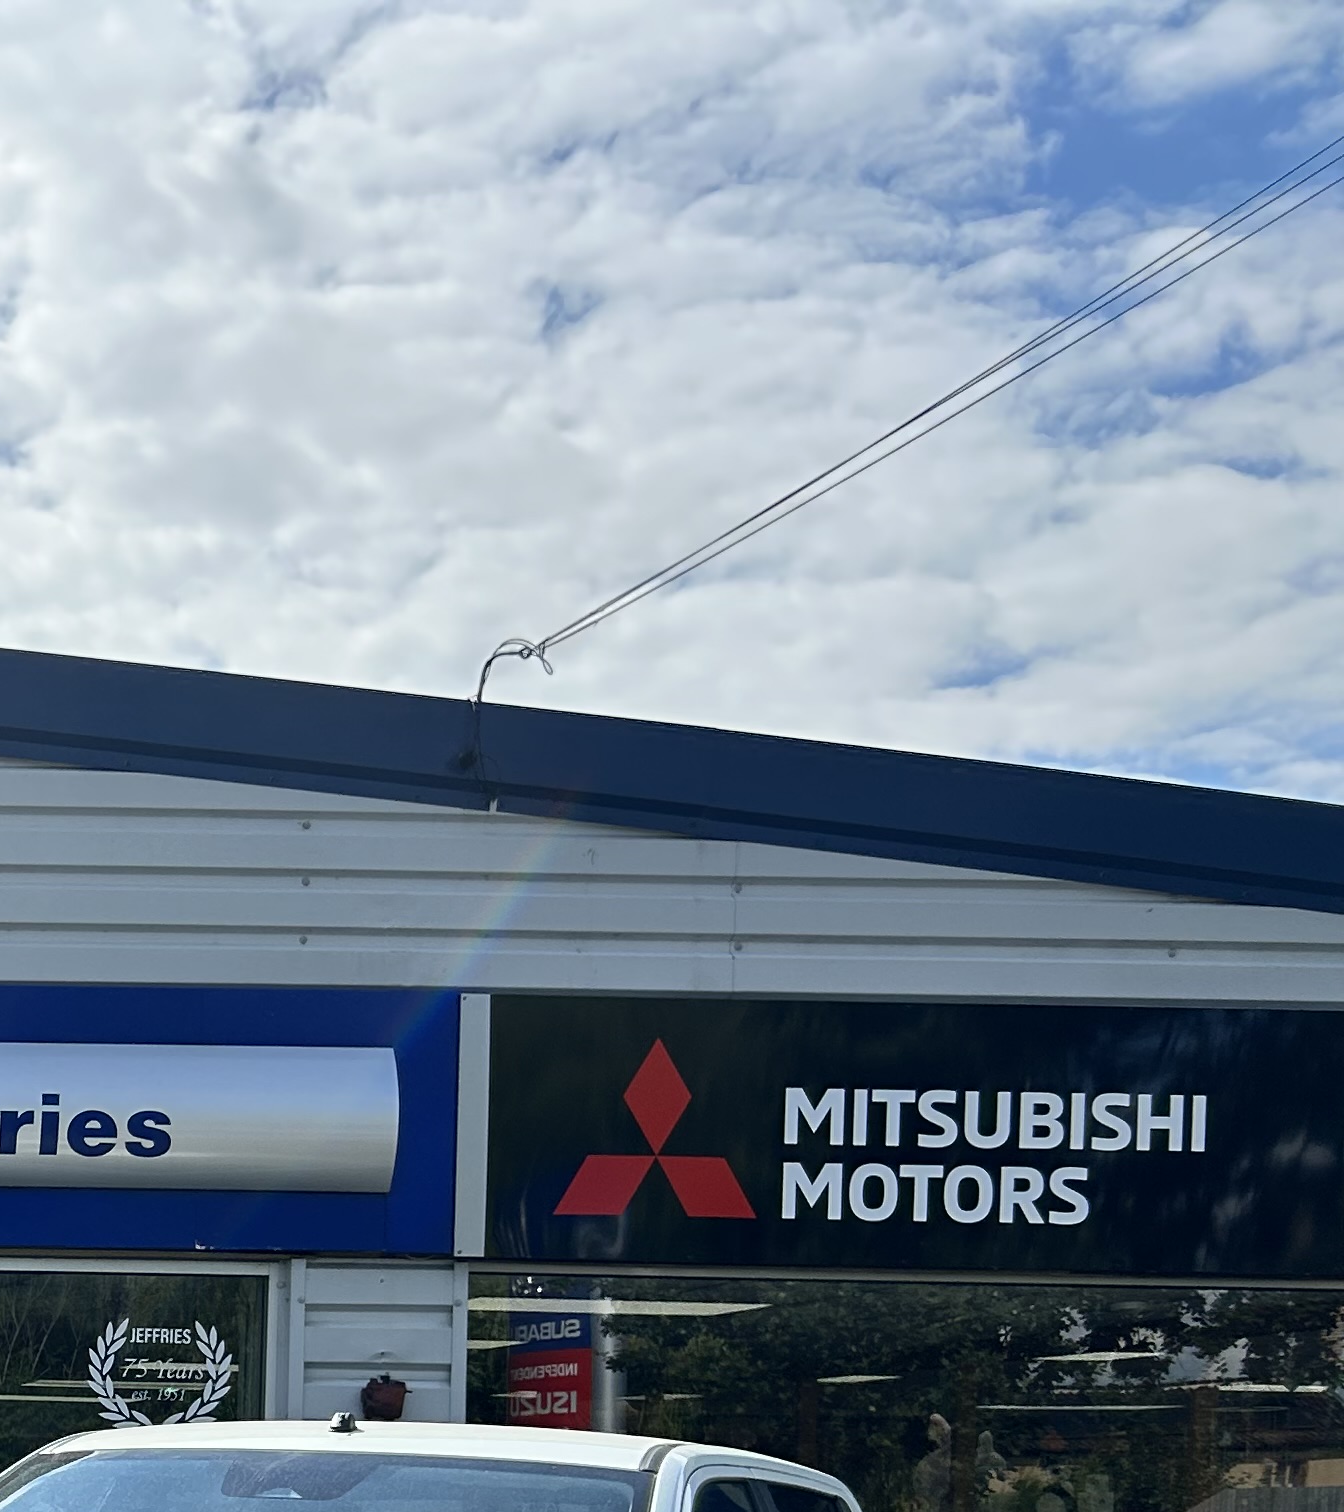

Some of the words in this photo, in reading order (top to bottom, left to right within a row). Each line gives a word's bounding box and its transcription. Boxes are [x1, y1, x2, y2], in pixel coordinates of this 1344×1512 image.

[784, 1087, 1207, 1152] MITSUBISHI
[782, 1162, 1089, 1225] MOTORS
[129, 1328, 192, 1344] JEFFRIES
[121, 1358, 149, 1378] 75
[152, 1357, 204, 1380] Years
